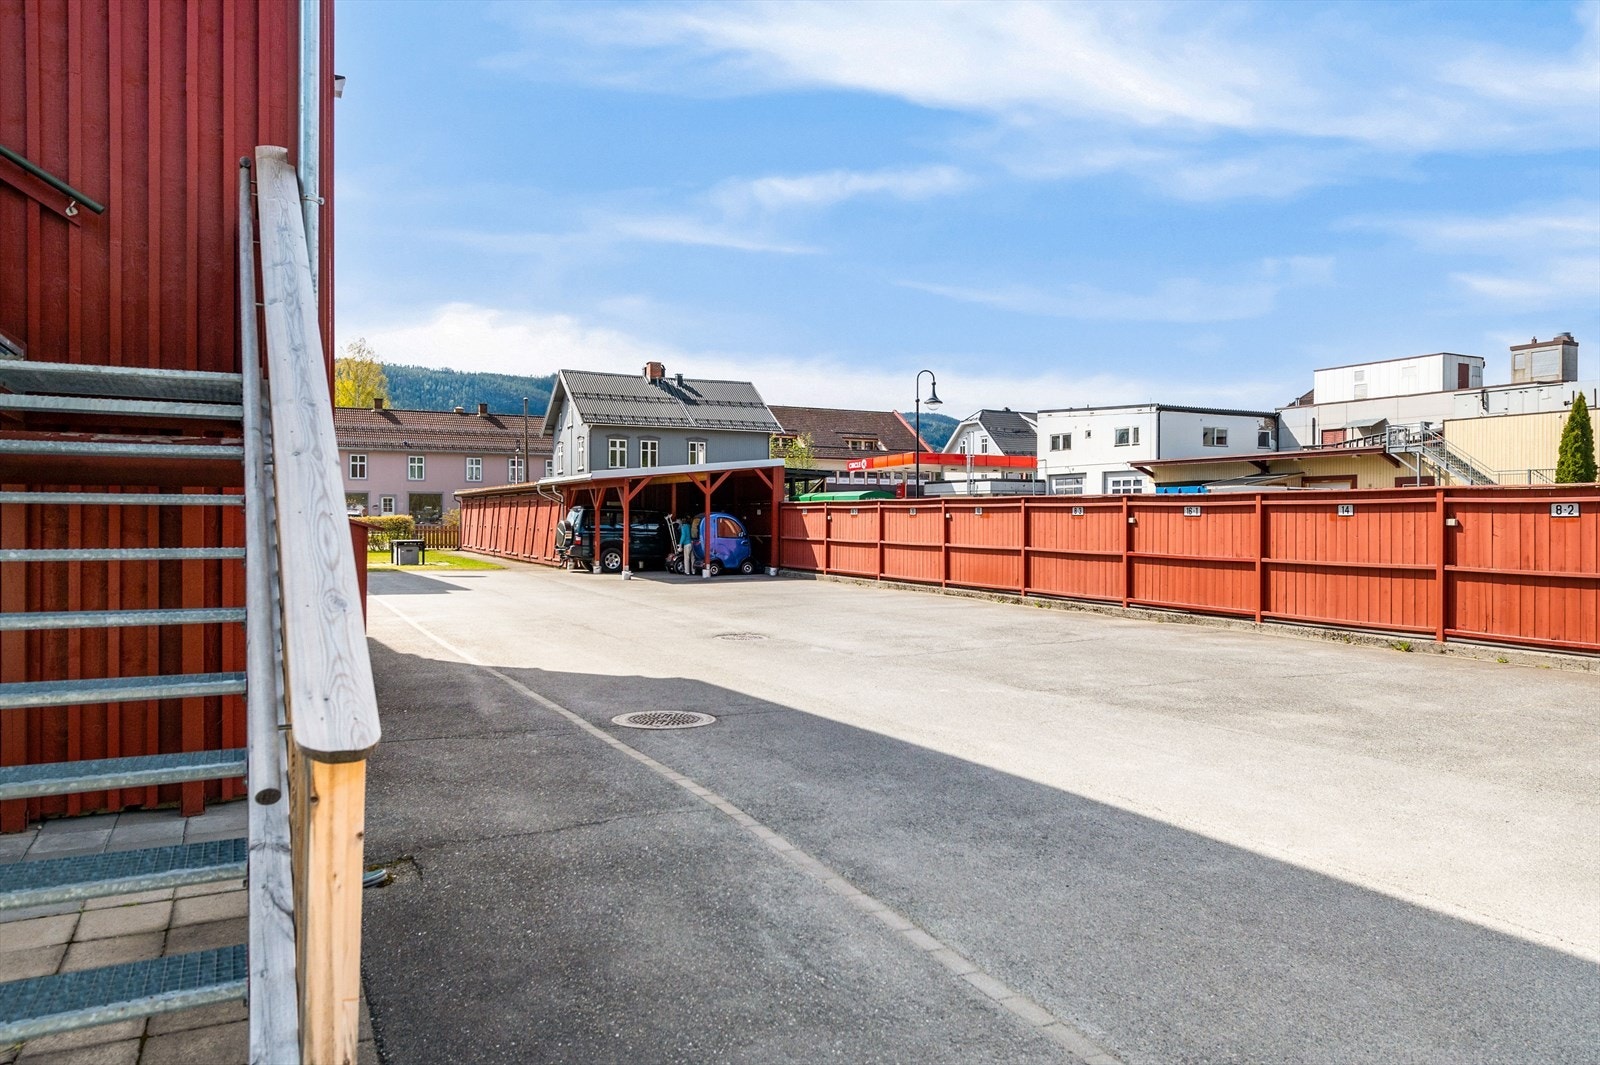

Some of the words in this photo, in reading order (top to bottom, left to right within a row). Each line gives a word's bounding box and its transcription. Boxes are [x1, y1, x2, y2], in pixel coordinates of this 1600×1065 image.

[848, 461, 861, 469] CIRCLE
[1186, 506, 1199, 515] 16-1
[1341, 505, 1350, 515] 14
[1555, 504, 1574, 515] 8-2
